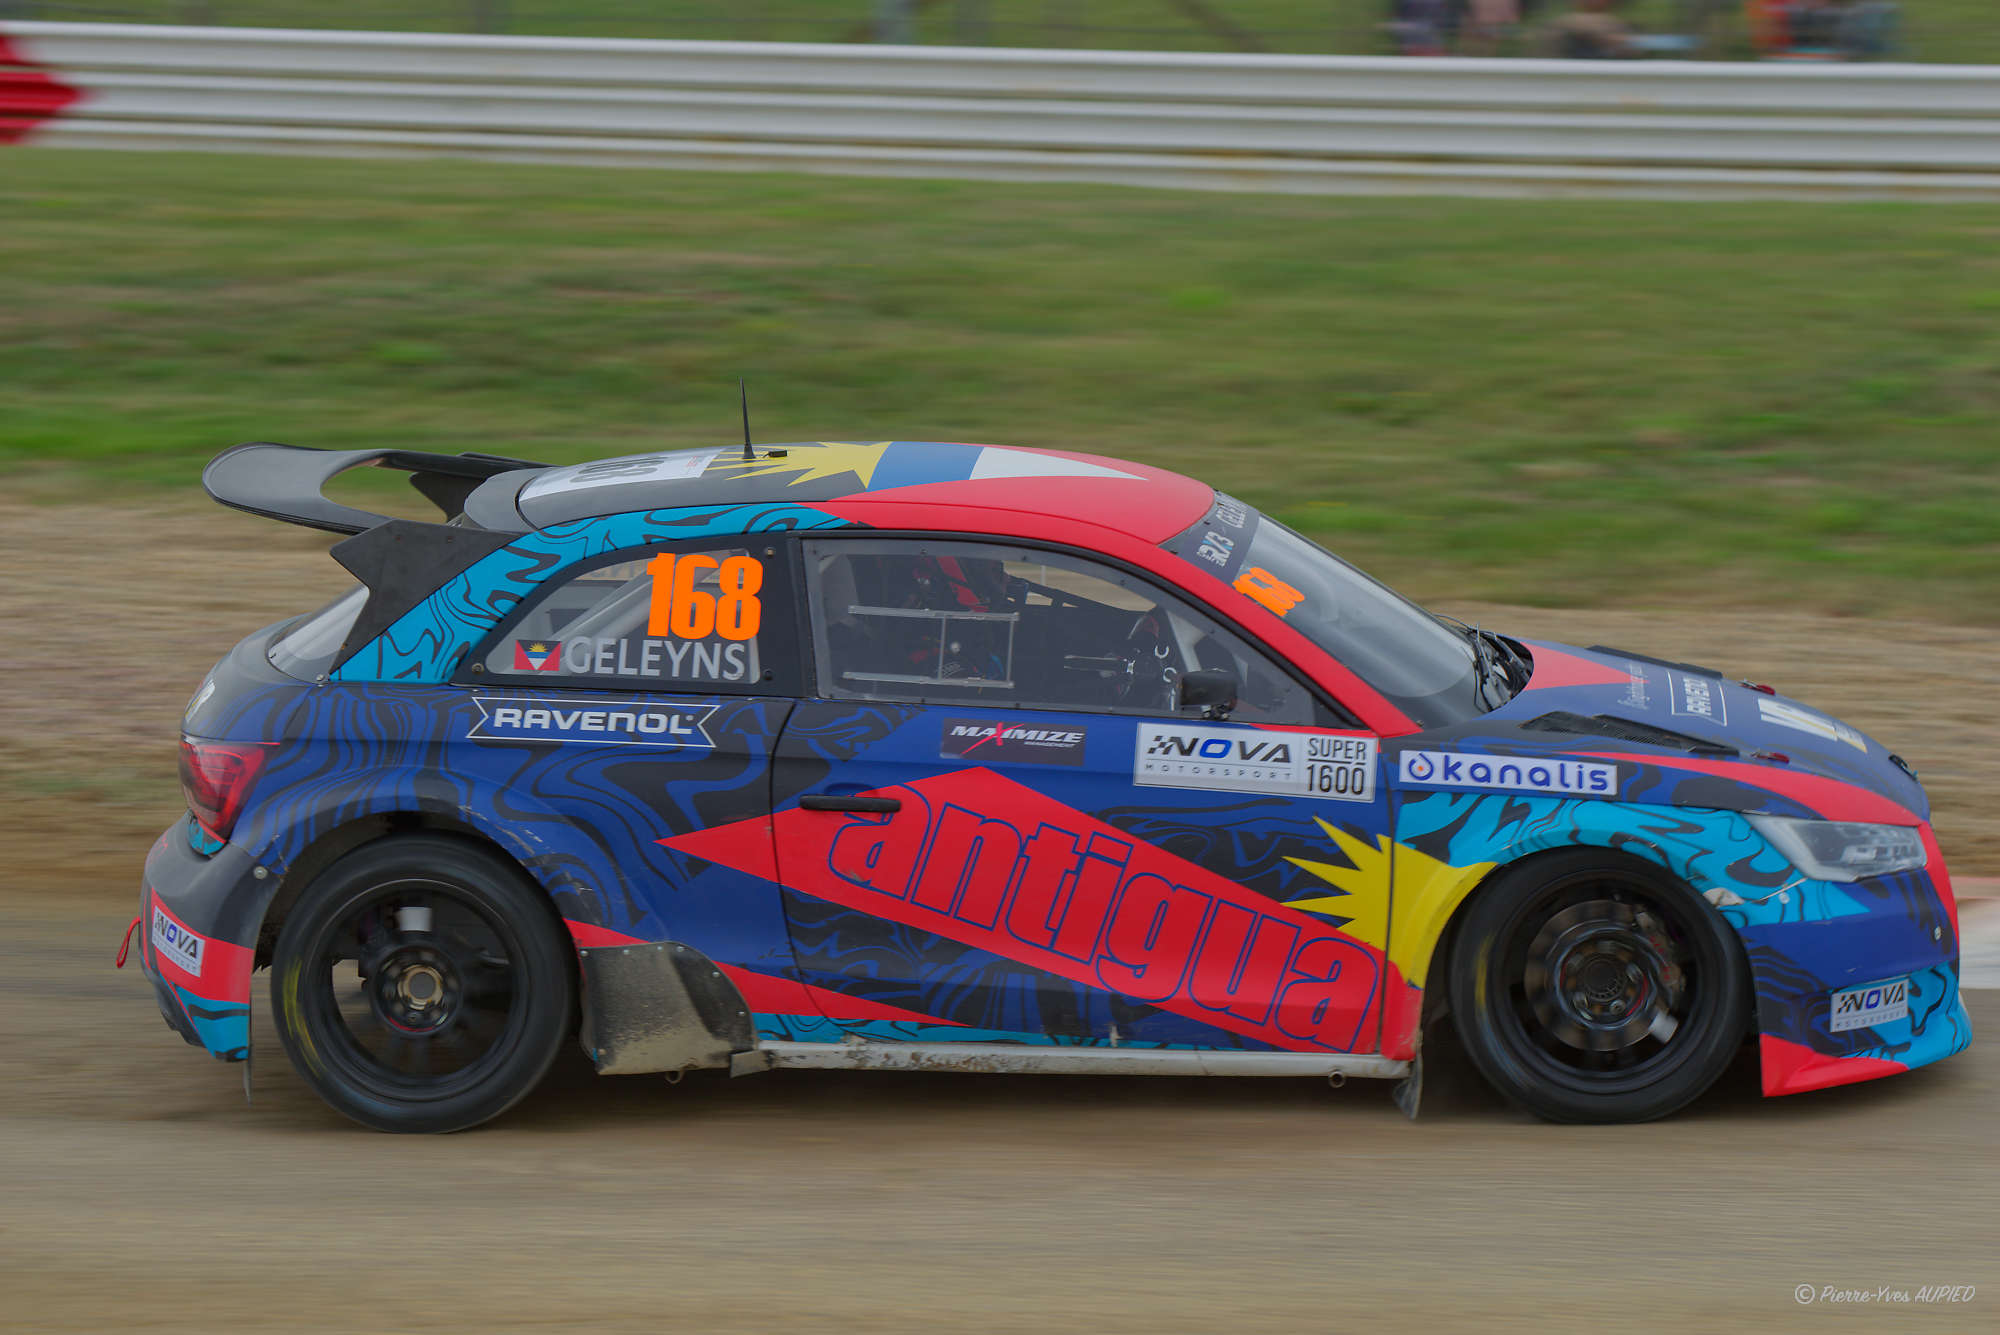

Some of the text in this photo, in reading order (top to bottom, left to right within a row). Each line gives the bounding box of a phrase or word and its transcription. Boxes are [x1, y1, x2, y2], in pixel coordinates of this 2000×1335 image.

[646, 552, 764, 640] 168
[565, 636, 745, 680] GELEYNS
[494, 708, 693, 735] RAVENOL
[950, 722, 1085, 746] MAXIMIZE
[1153, 736, 1291, 763] NOVA
[1308, 737, 1366, 760] SUPER
[1307, 764, 1365, 795] 1600
[1443, 755, 1608, 791] kanalis
[828, 783, 1378, 1053] antigua
